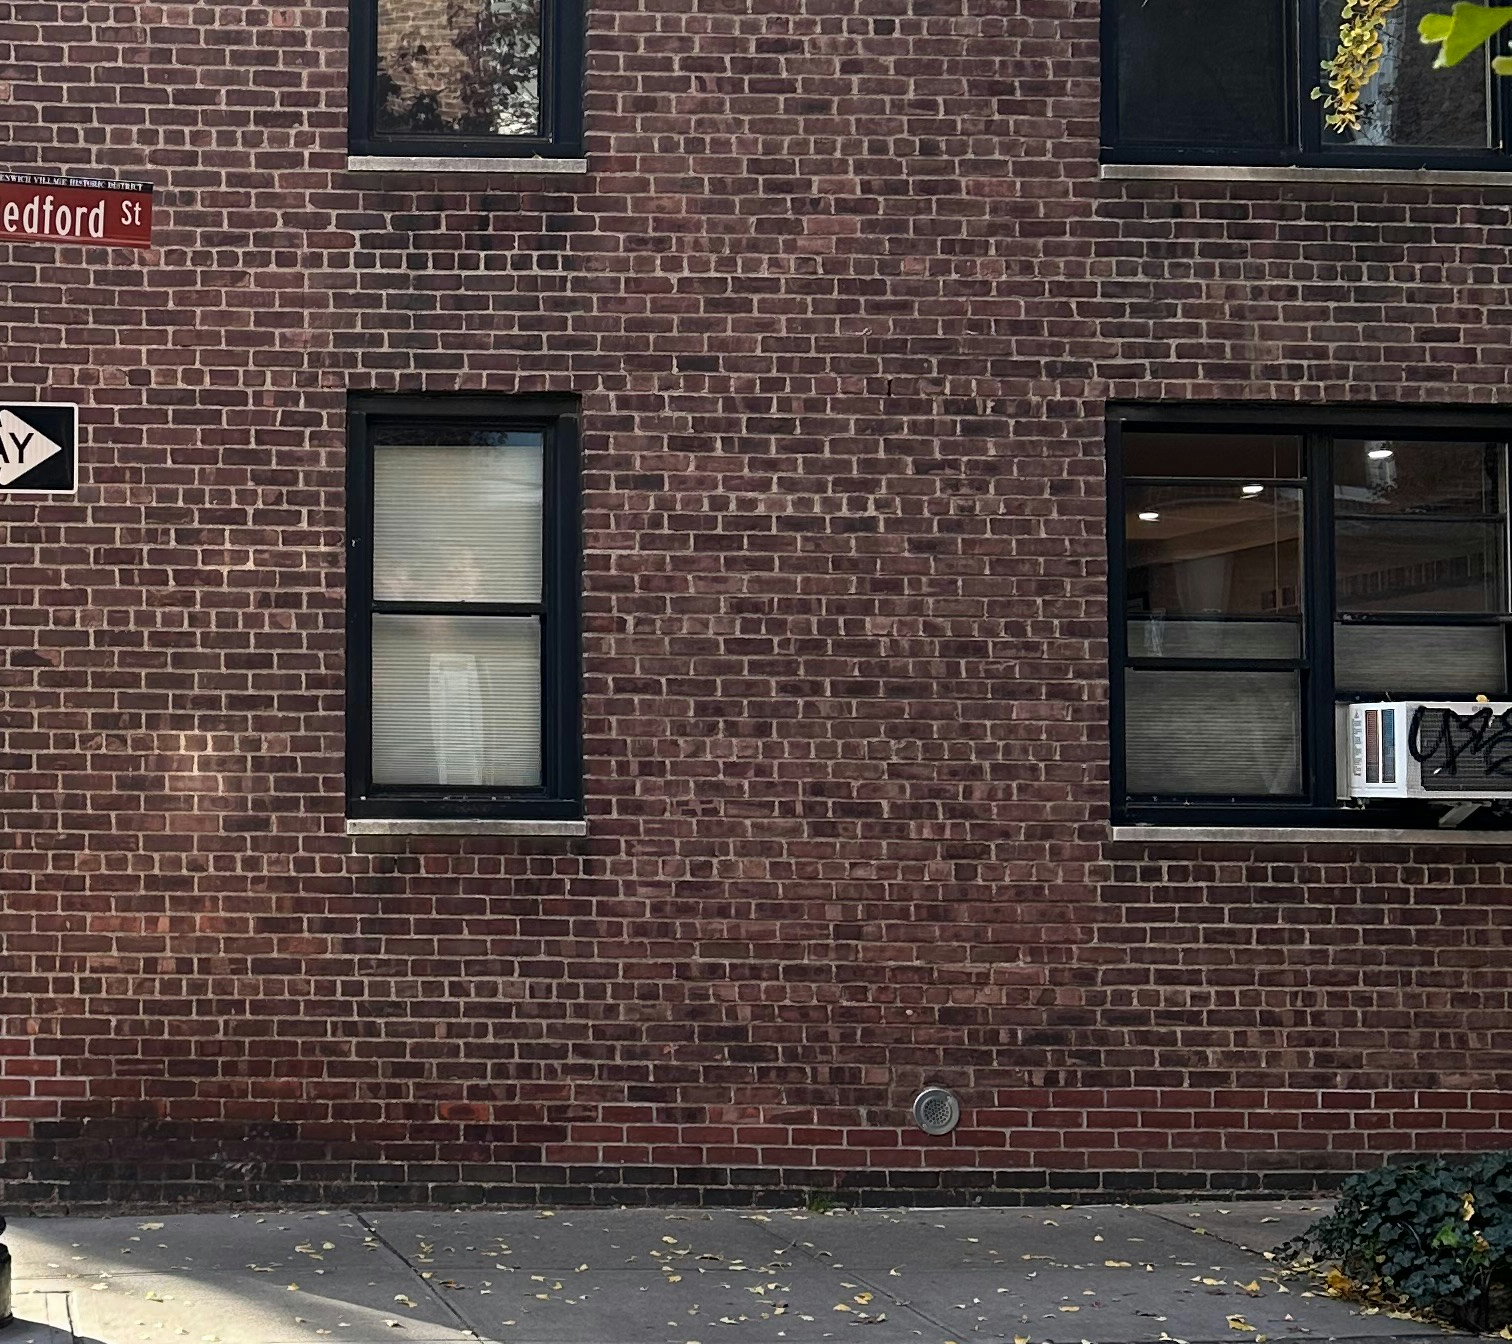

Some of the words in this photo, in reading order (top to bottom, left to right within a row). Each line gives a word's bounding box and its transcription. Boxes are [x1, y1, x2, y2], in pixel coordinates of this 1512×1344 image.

[34, 176, 68, 186] VILLAGE
[69, 178, 106, 189] HISTORIC
[107, 181, 143, 192] DISTRICT
[120, 200, 142, 226] St
